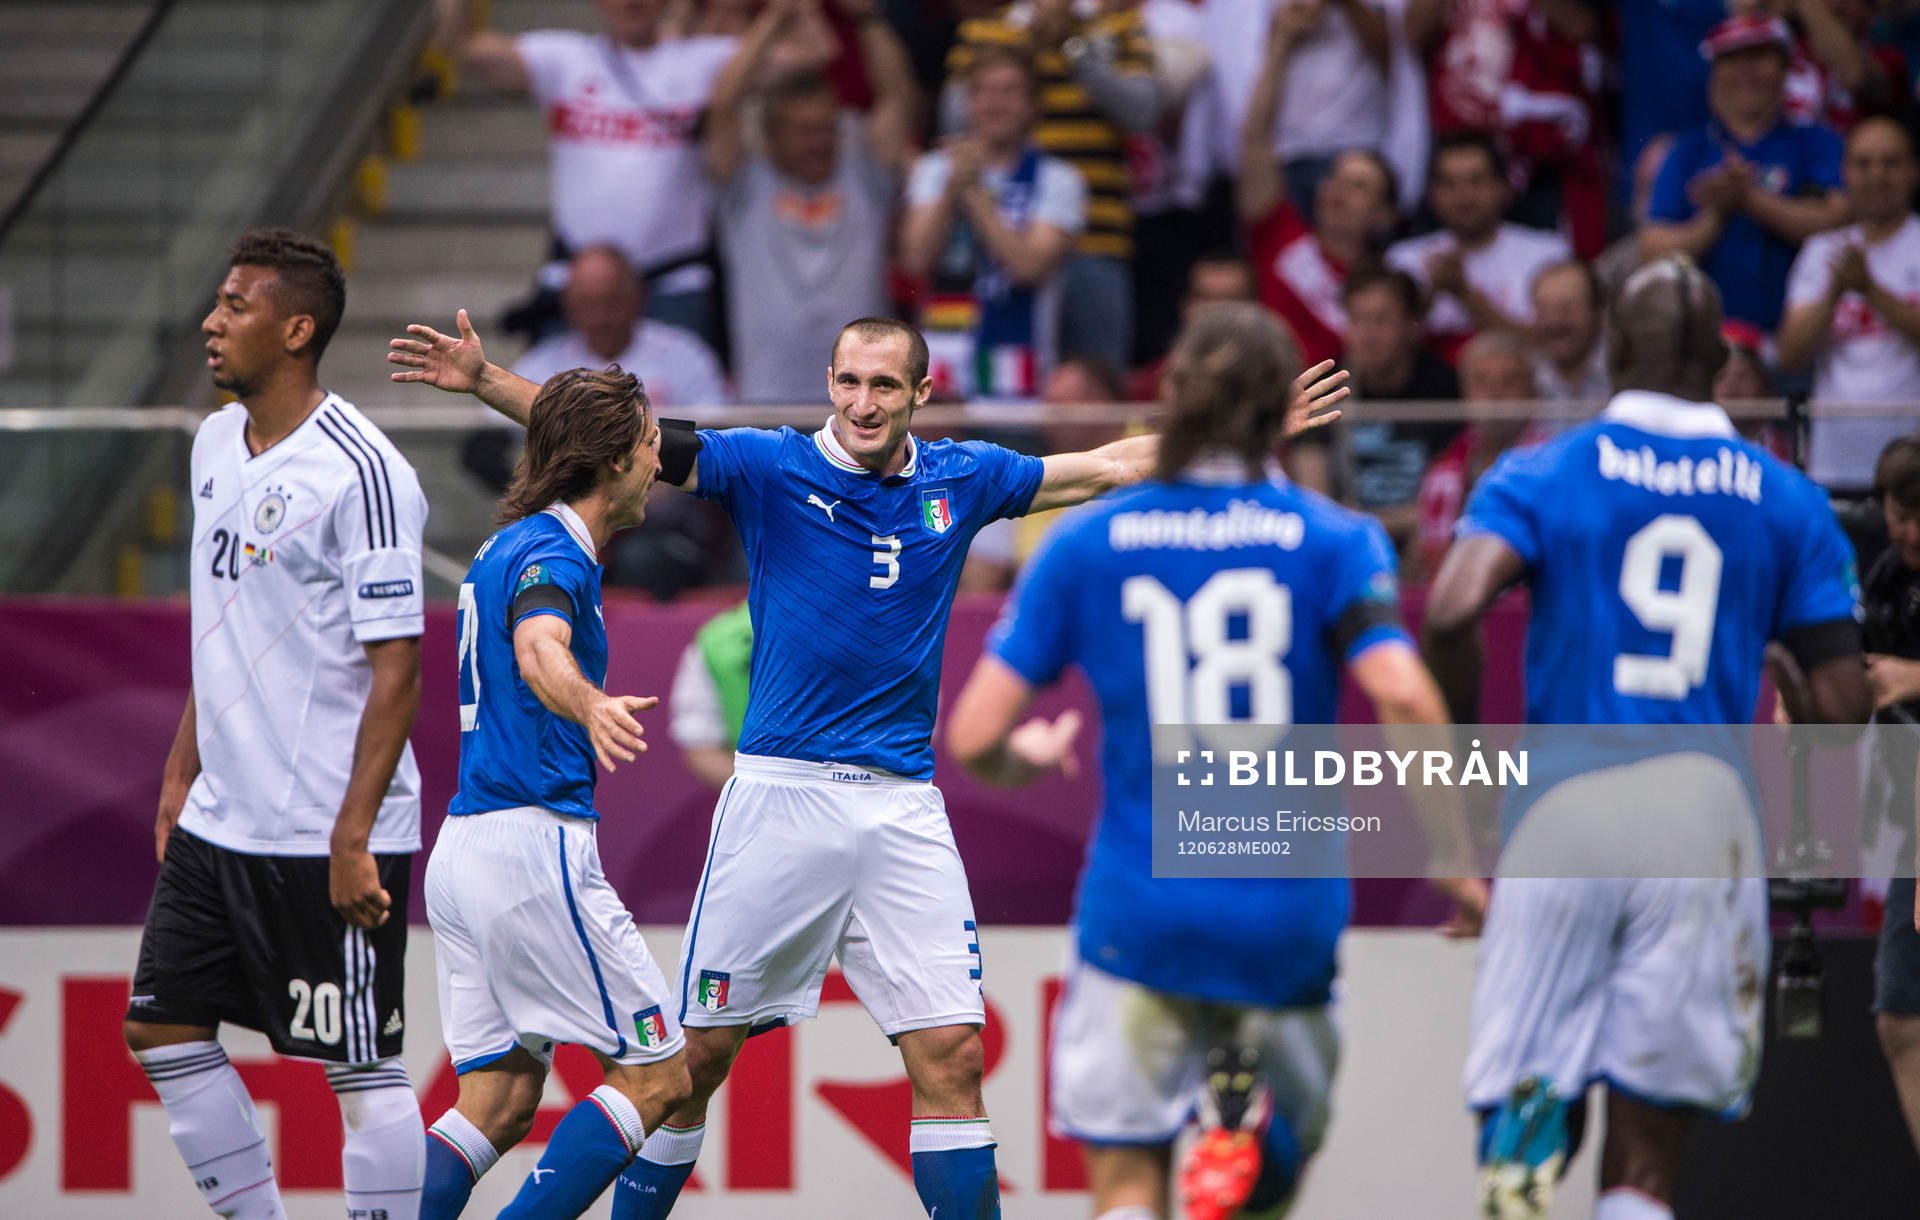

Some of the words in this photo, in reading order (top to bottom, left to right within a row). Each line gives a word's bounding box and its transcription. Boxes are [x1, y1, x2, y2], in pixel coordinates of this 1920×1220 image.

[212, 528, 240, 581] 20
[870, 534, 902, 589] 3
[1613, 513, 1723, 701] 9
[1121, 568, 1293, 766] 18
[833, 771, 871, 781] ITALIA
[289, 978, 342, 1046] 20
[619, 1173, 657, 1194] ITALIA
